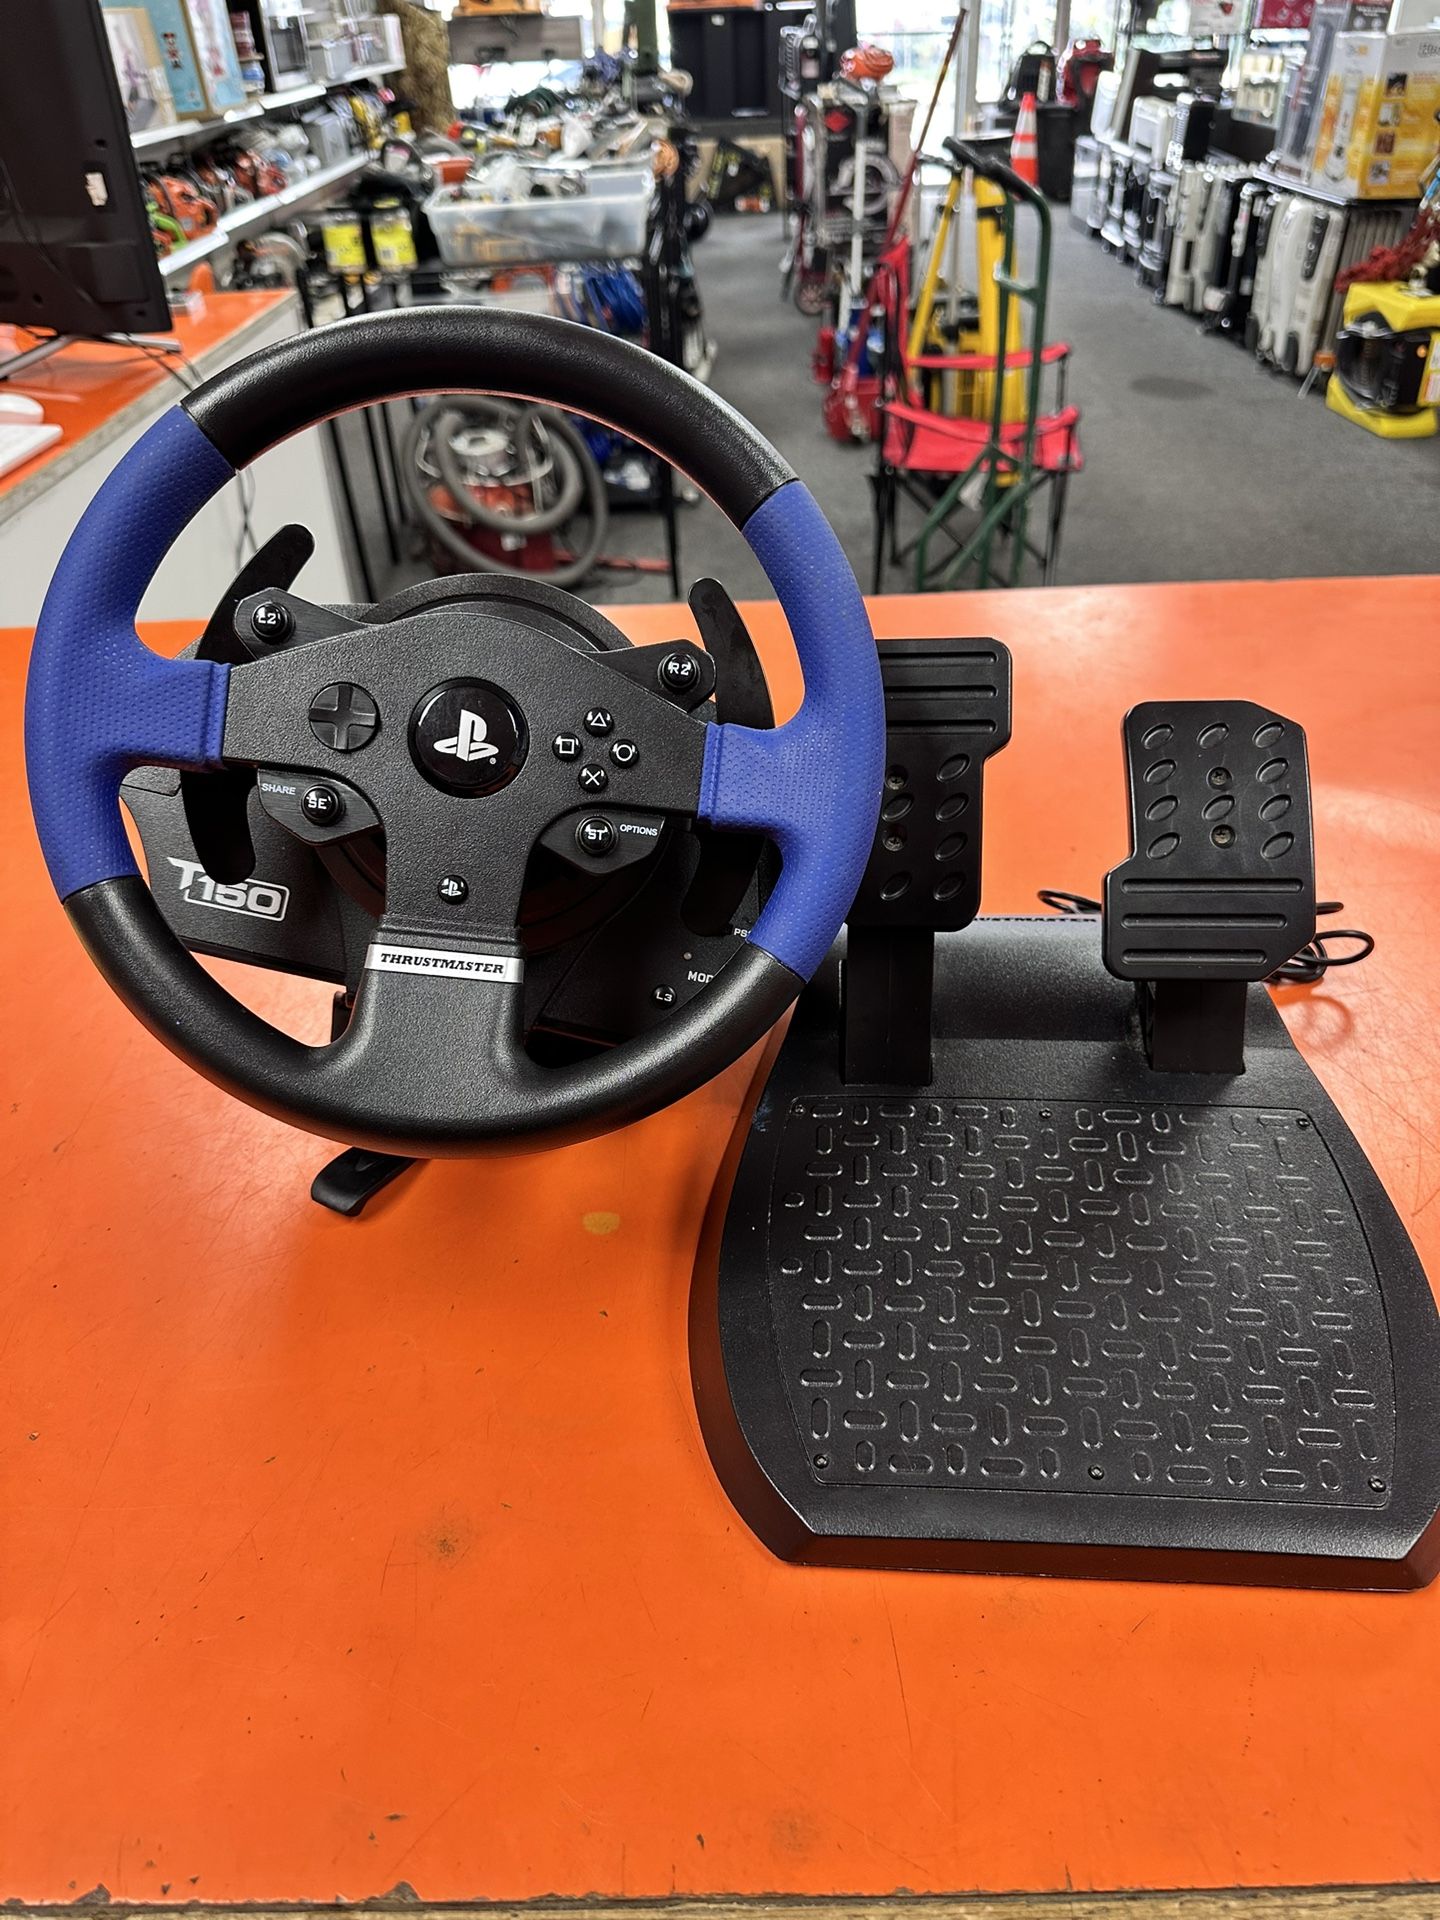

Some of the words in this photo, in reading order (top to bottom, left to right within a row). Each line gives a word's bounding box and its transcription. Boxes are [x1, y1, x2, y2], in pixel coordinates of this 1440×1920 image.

[258, 612, 277, 625] L2
[668, 662, 692, 676] R2
[261, 782, 296, 796] SHARE
[307, 797, 328, 810] SE
[587, 828, 605, 841] ST
[619, 823, 658, 837] OPTIONS
[166, 856, 283, 915] T150
[733, 927, 751, 938] PS
[380, 952, 504, 974] THRUSTMASTER
[655, 991, 673, 1002] L3
